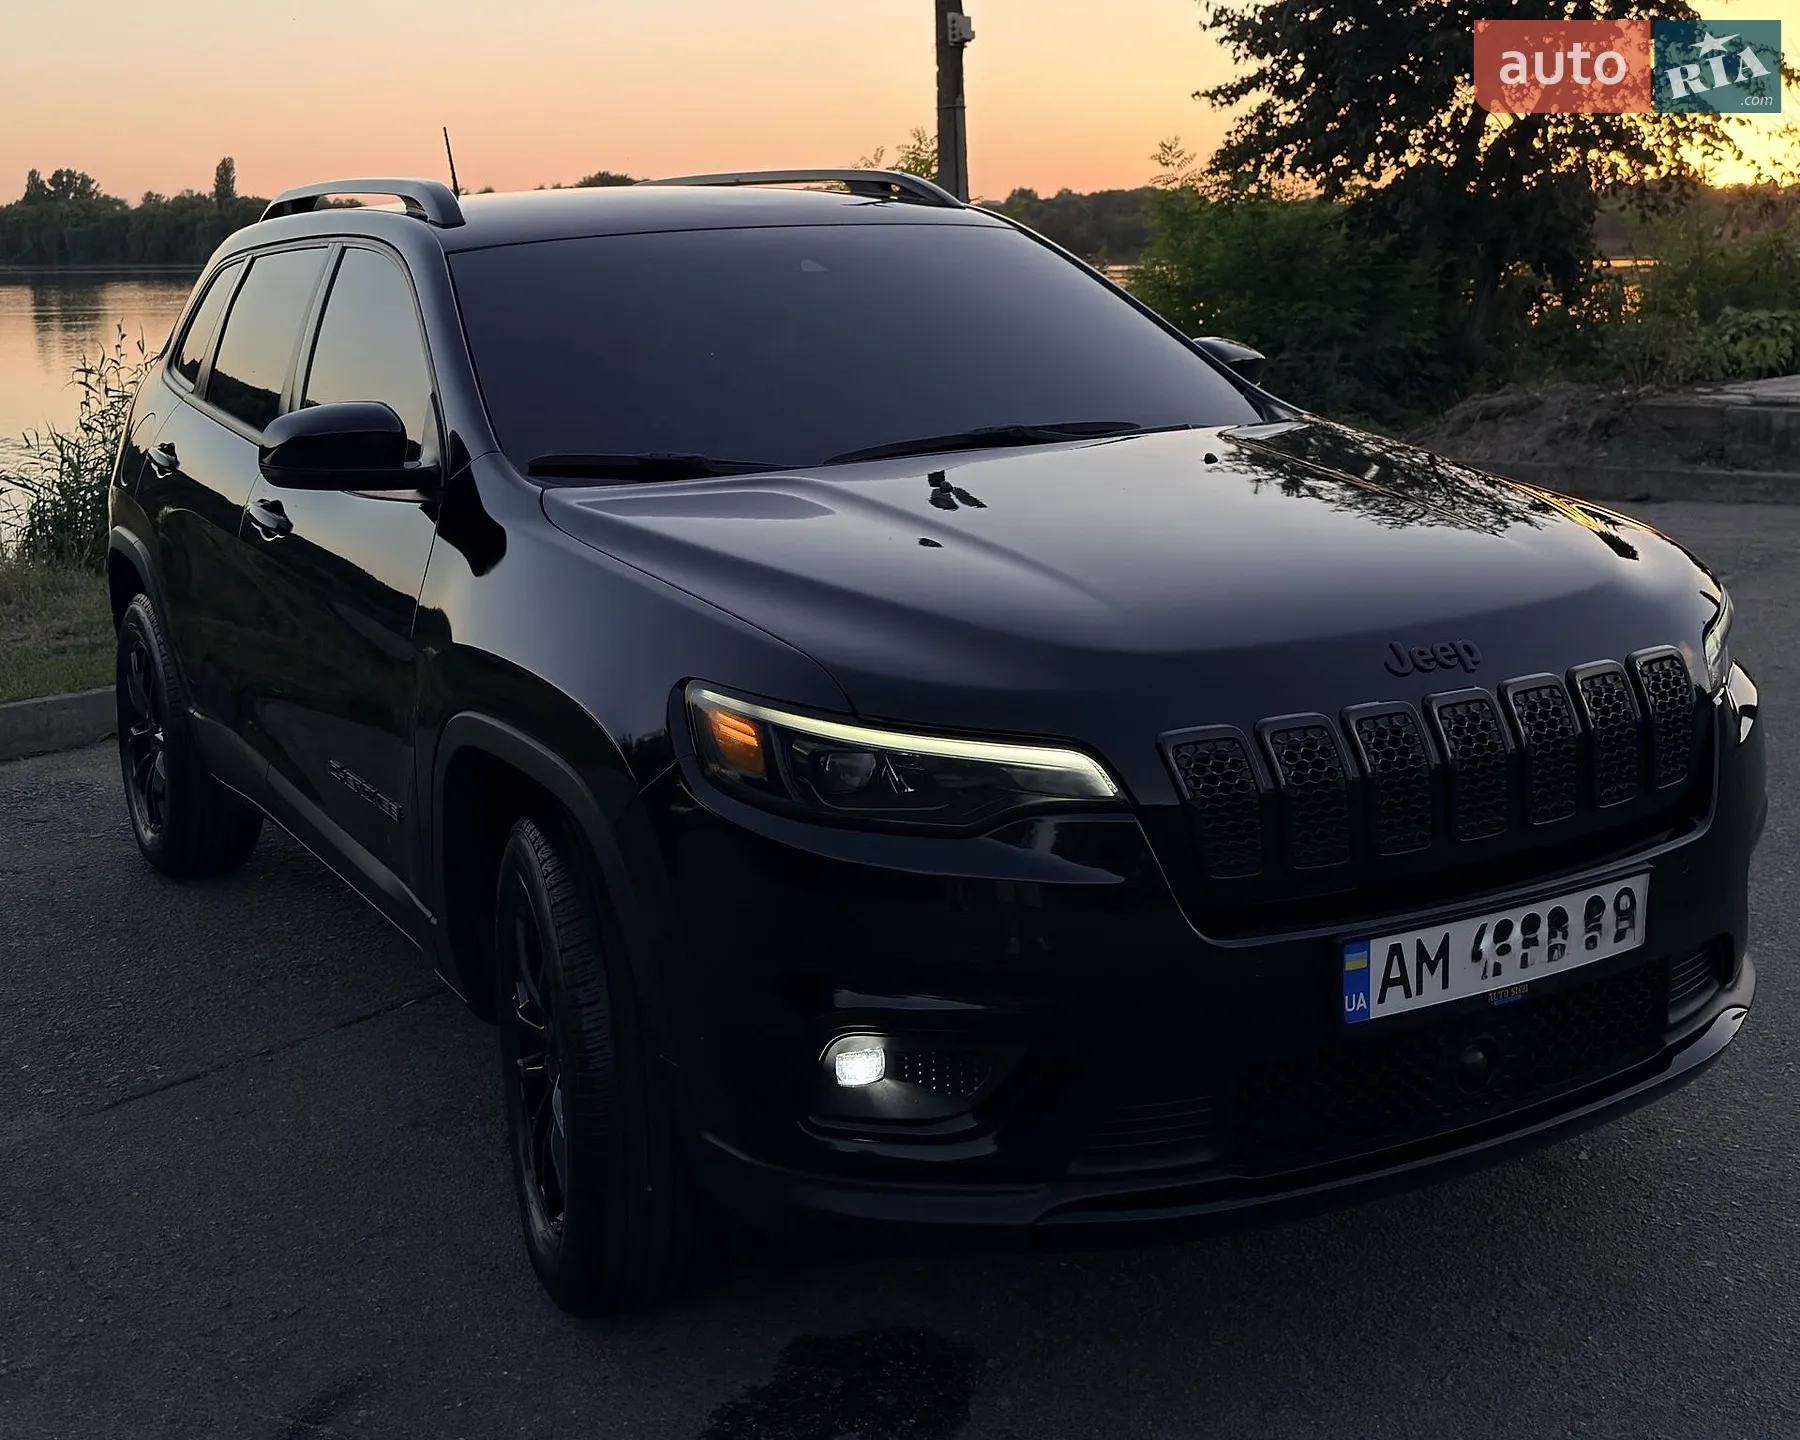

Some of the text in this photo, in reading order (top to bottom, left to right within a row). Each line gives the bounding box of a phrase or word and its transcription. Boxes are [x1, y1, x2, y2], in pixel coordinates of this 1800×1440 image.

[1383, 639, 1483, 677] Jeep
[1376, 931, 1450, 1006] AM
[1344, 992, 1368, 1013] UA
